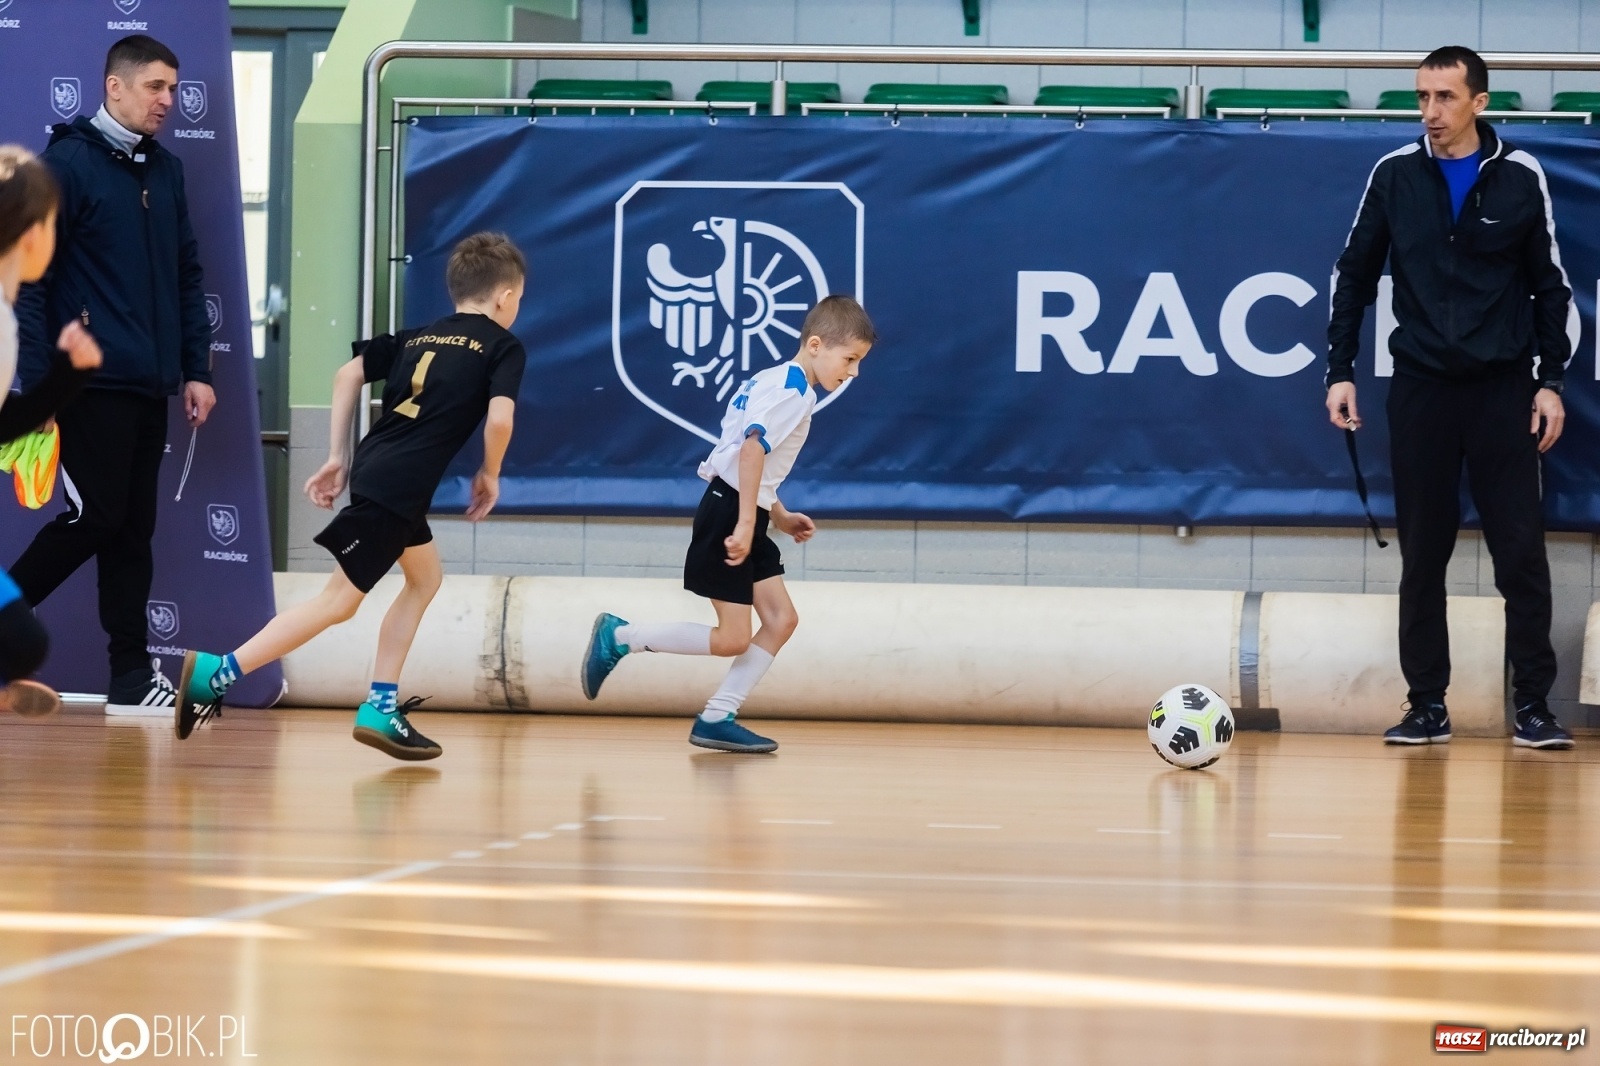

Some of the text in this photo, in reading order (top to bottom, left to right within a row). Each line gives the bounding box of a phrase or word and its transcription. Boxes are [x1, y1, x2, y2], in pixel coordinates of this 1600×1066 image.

[107, 19, 148, 30] RACIBÓRZ
[174, 128, 215, 139] RACIBÓRZ
[468, 340, 483, 353] W.
[393, 351, 436, 418] 1
[203, 550, 248, 562] RACIBÓRZ
[390, 717, 409, 738] FILA
